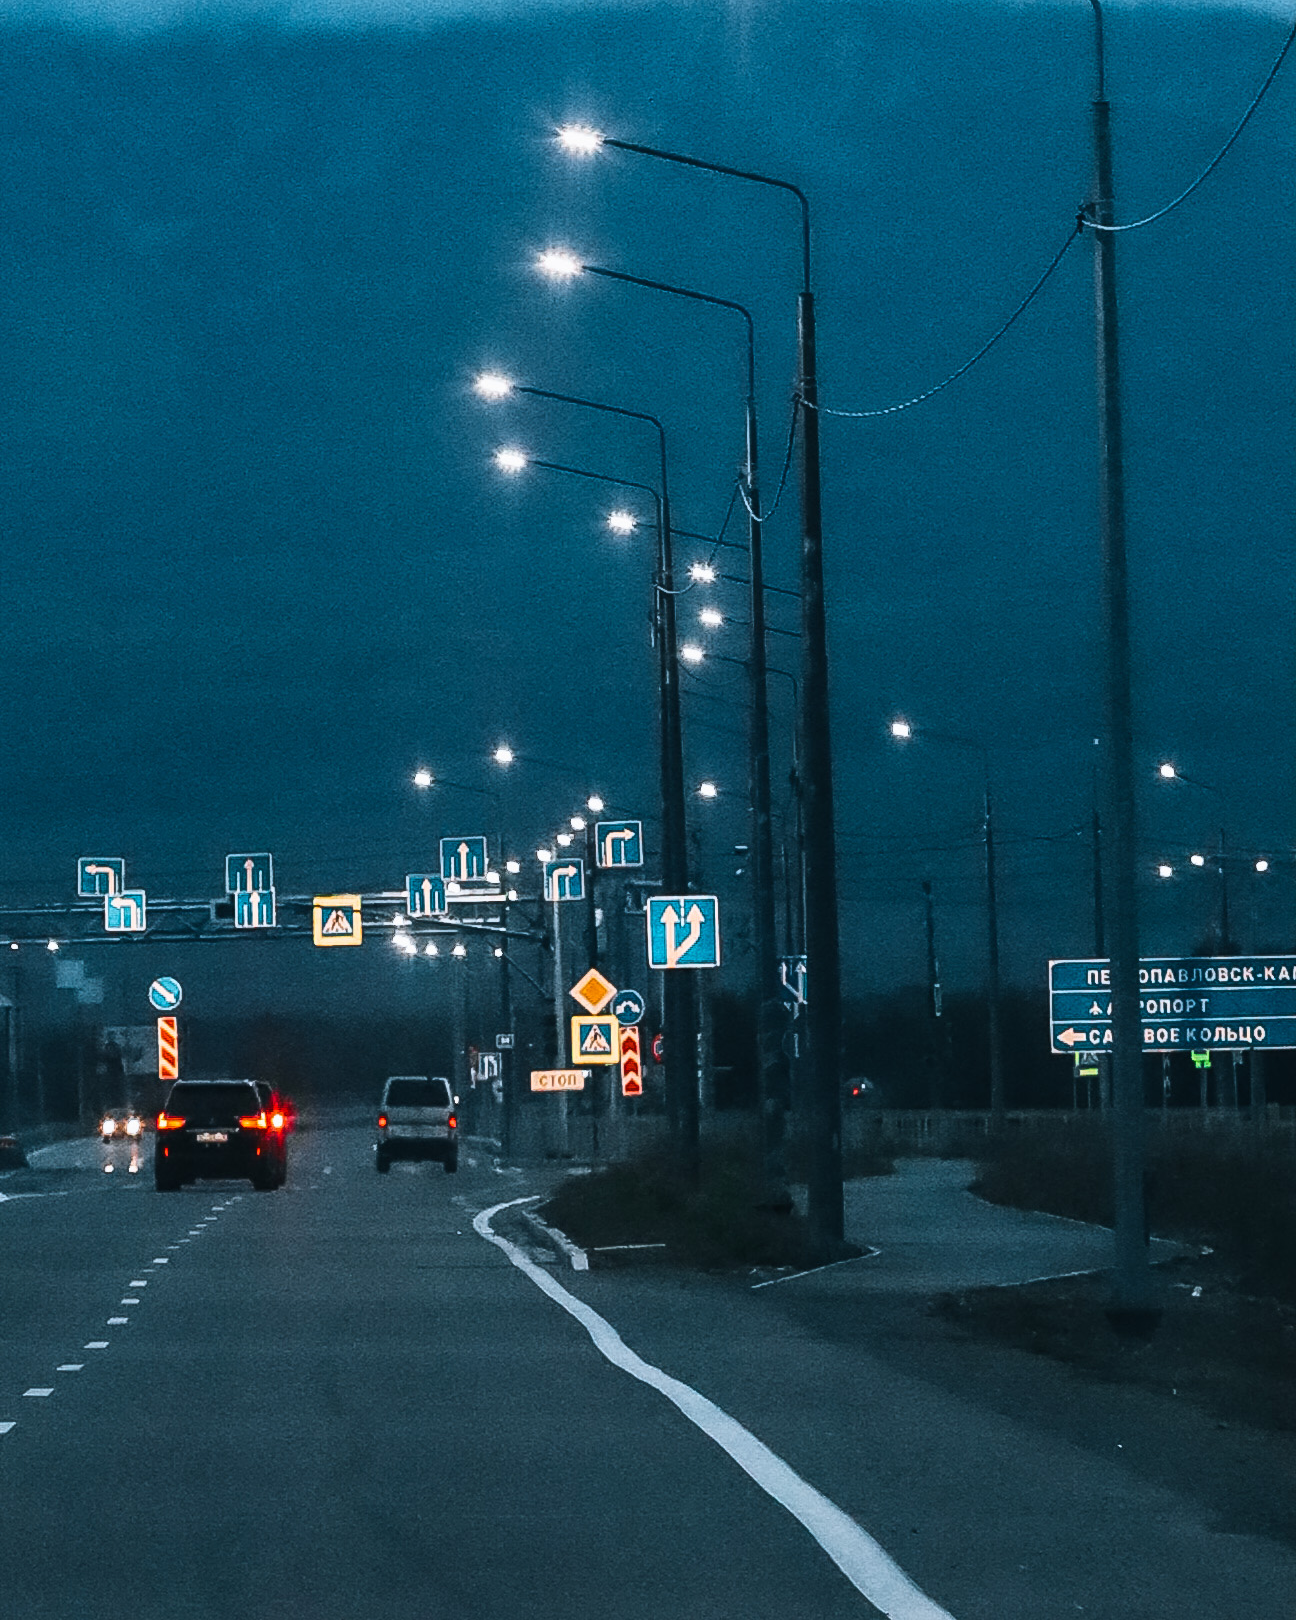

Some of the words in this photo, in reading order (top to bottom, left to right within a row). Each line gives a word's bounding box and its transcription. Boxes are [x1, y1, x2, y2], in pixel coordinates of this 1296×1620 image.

[1087, 965, 1296, 985] ПЕОПАВЛОВСК-КА
[1107, 998, 1210, 1016] ОПОРТ
[1089, 1027, 1180, 1045] САВОЕ
[1186, 1025, 1266, 1044] КОЛЬЦО
[539, 1074, 577, 1087] СТОП
